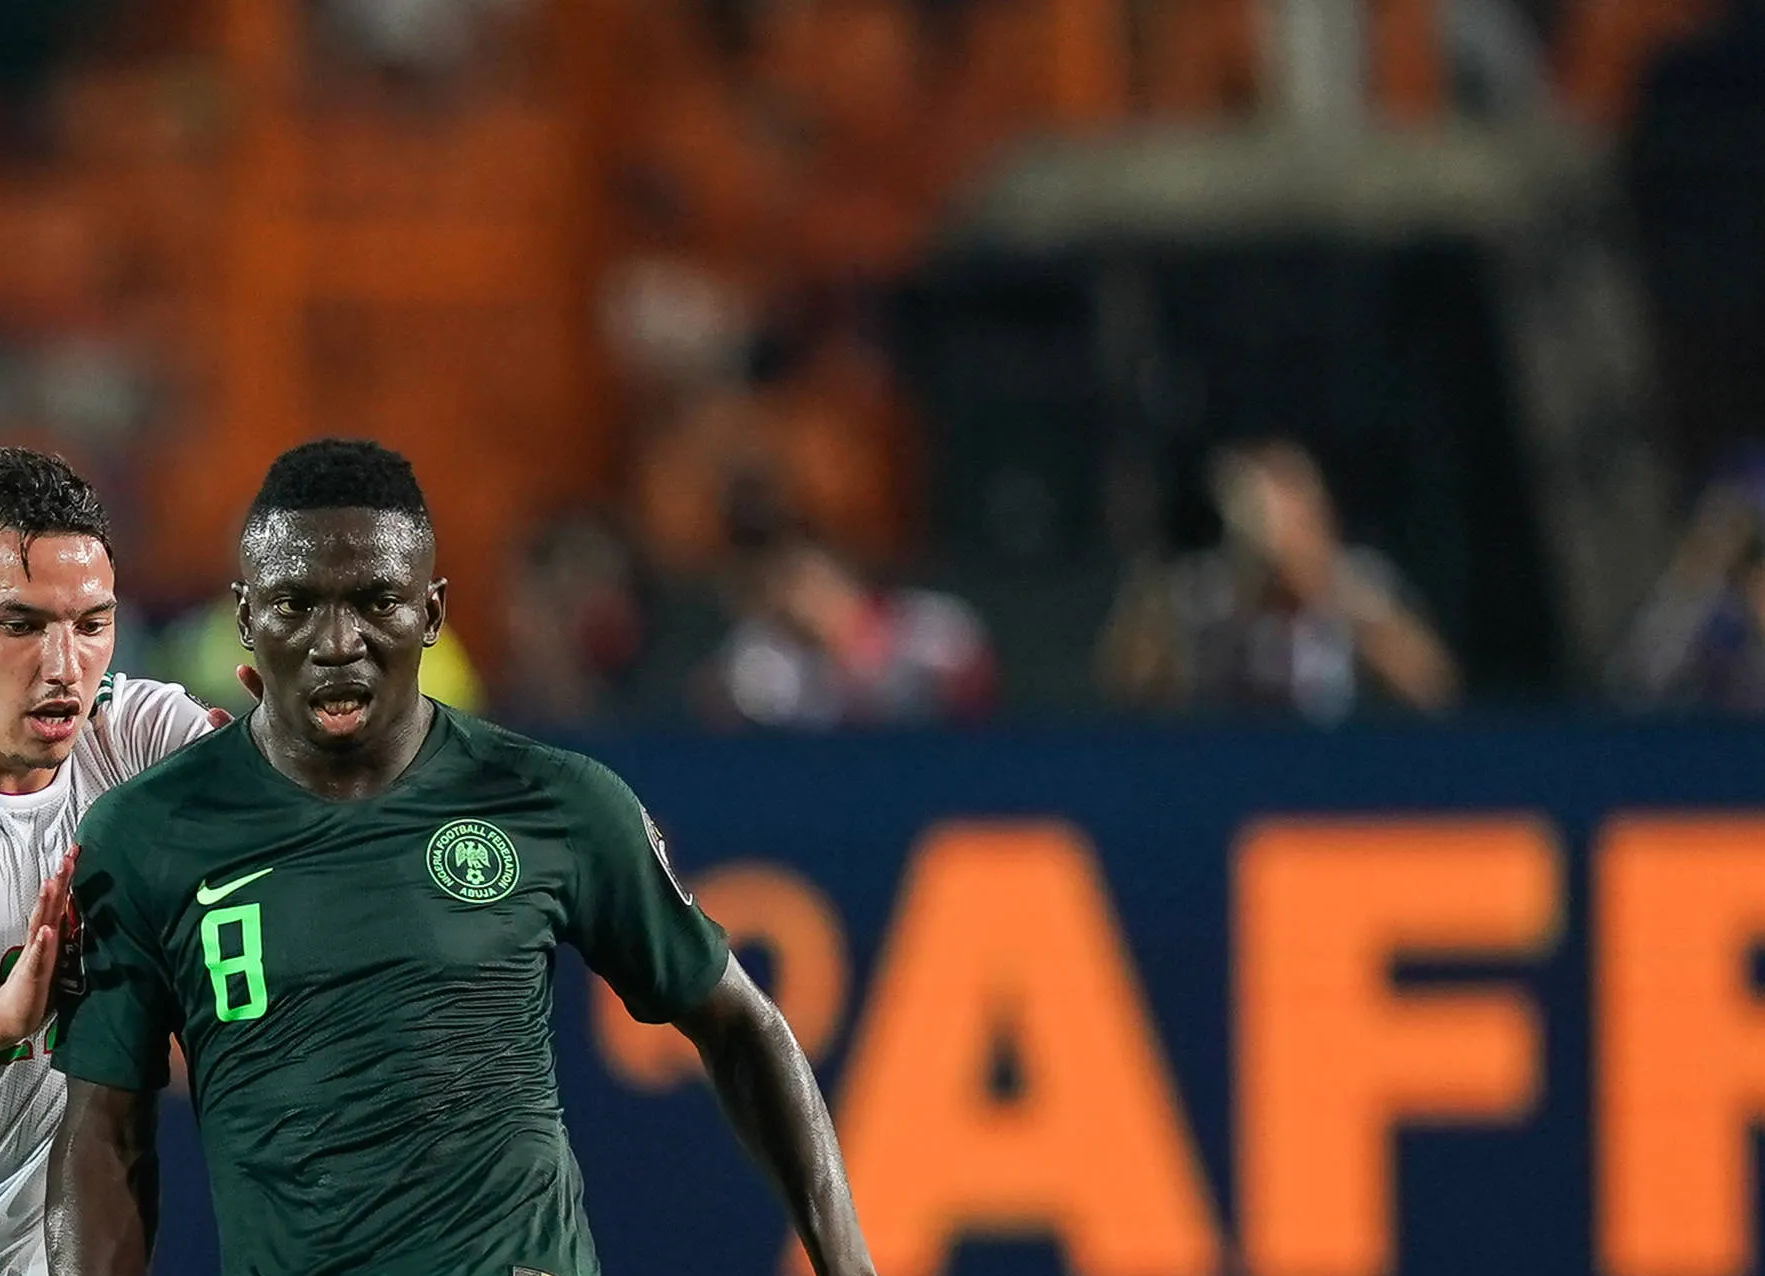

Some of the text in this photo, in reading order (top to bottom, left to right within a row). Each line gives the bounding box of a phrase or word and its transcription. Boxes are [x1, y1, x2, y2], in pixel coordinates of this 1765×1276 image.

[436, 824, 486, 850] FOOTBALL
[487, 830, 515, 890] FEDERATION
[459, 887, 498, 898] ABUJA
[200, 902, 268, 1023] 8
